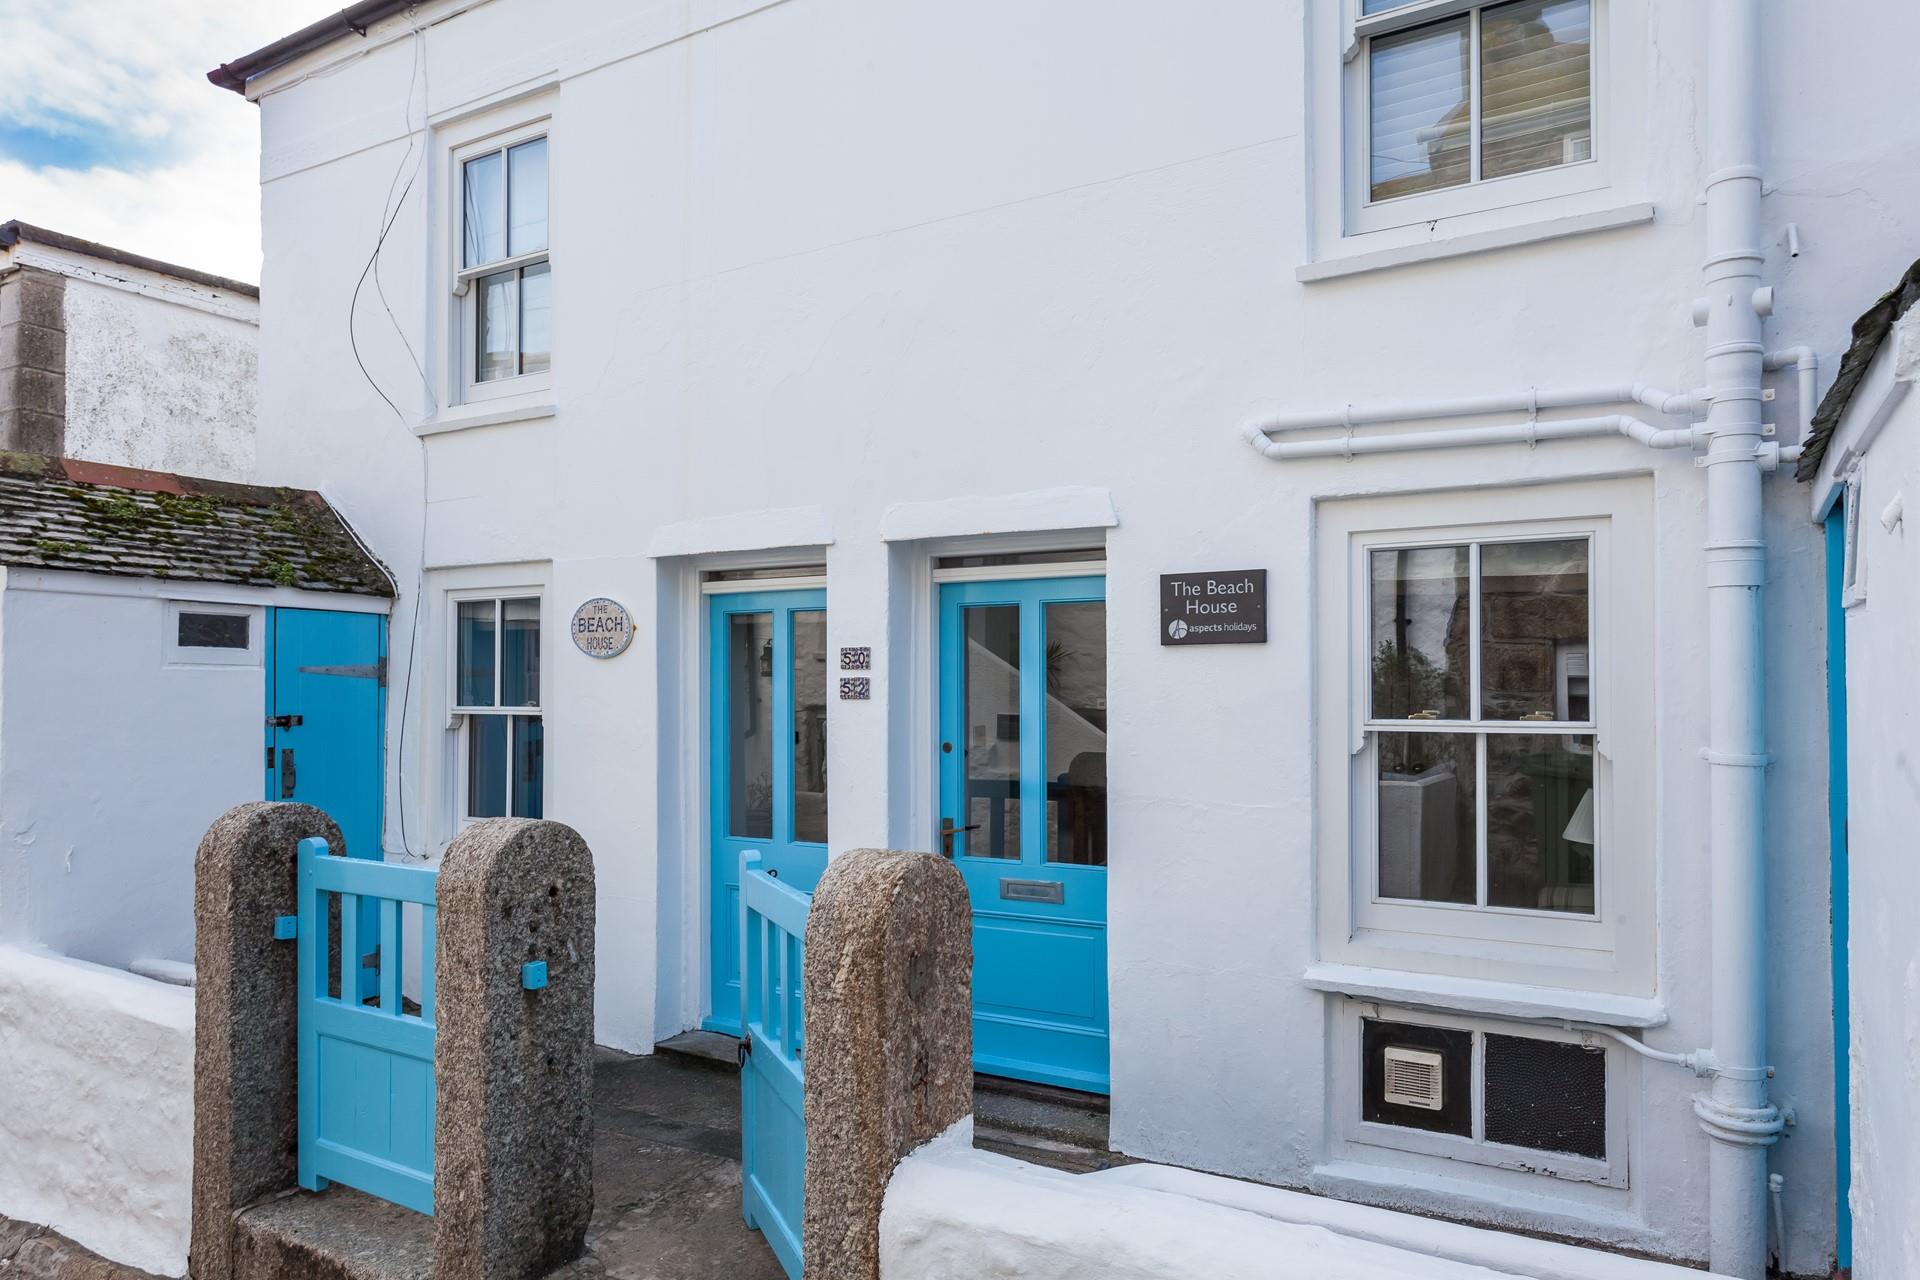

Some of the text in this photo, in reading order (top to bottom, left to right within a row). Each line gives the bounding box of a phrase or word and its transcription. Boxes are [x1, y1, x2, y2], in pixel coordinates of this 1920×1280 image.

[1170, 578, 1254, 597] The Beach
[592, 605, 608, 615] THE
[1186, 599, 1238, 614] House
[578, 616, 623, 633] BEACH
[1189, 621, 1257, 634] aspects holidays
[586, 636, 613, 650] HOUSE
